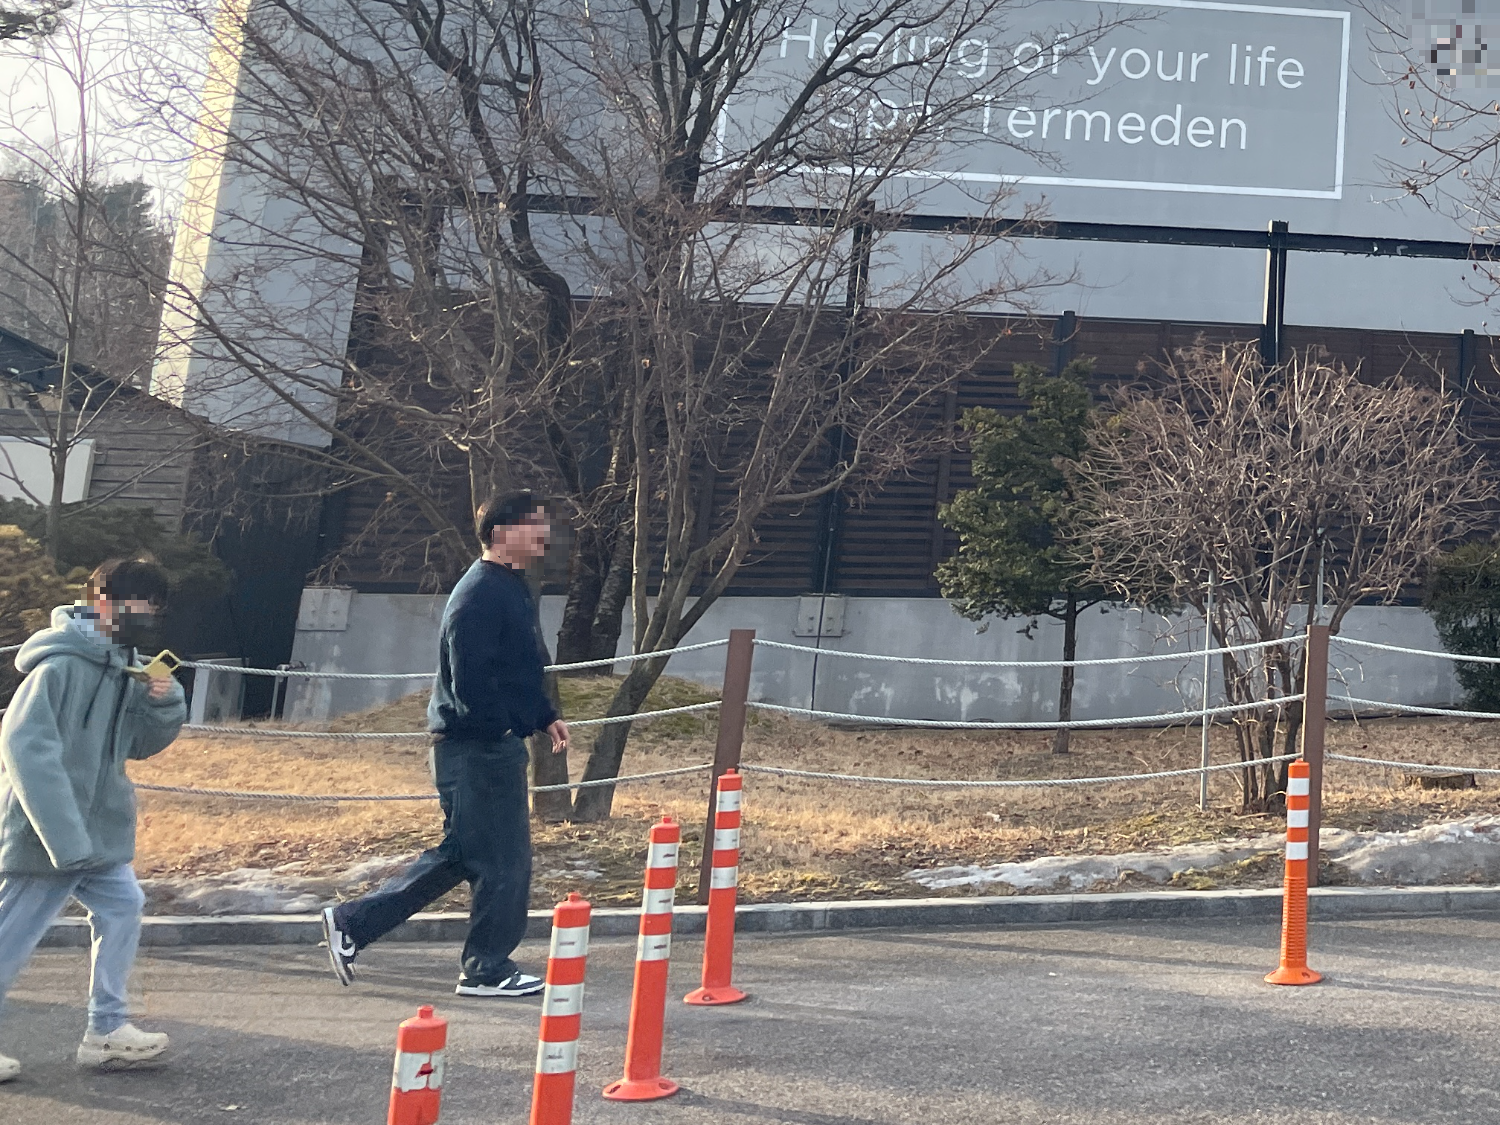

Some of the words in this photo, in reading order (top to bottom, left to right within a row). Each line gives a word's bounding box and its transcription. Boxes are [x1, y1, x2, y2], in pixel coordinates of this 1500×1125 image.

[780, 16, 989, 79] Healing
[1013, 32, 1070, 75] of
[1086, 45, 1209, 86] your
[1229, 43, 1305, 89] life
[972, 92, 1248, 151] Termeden
